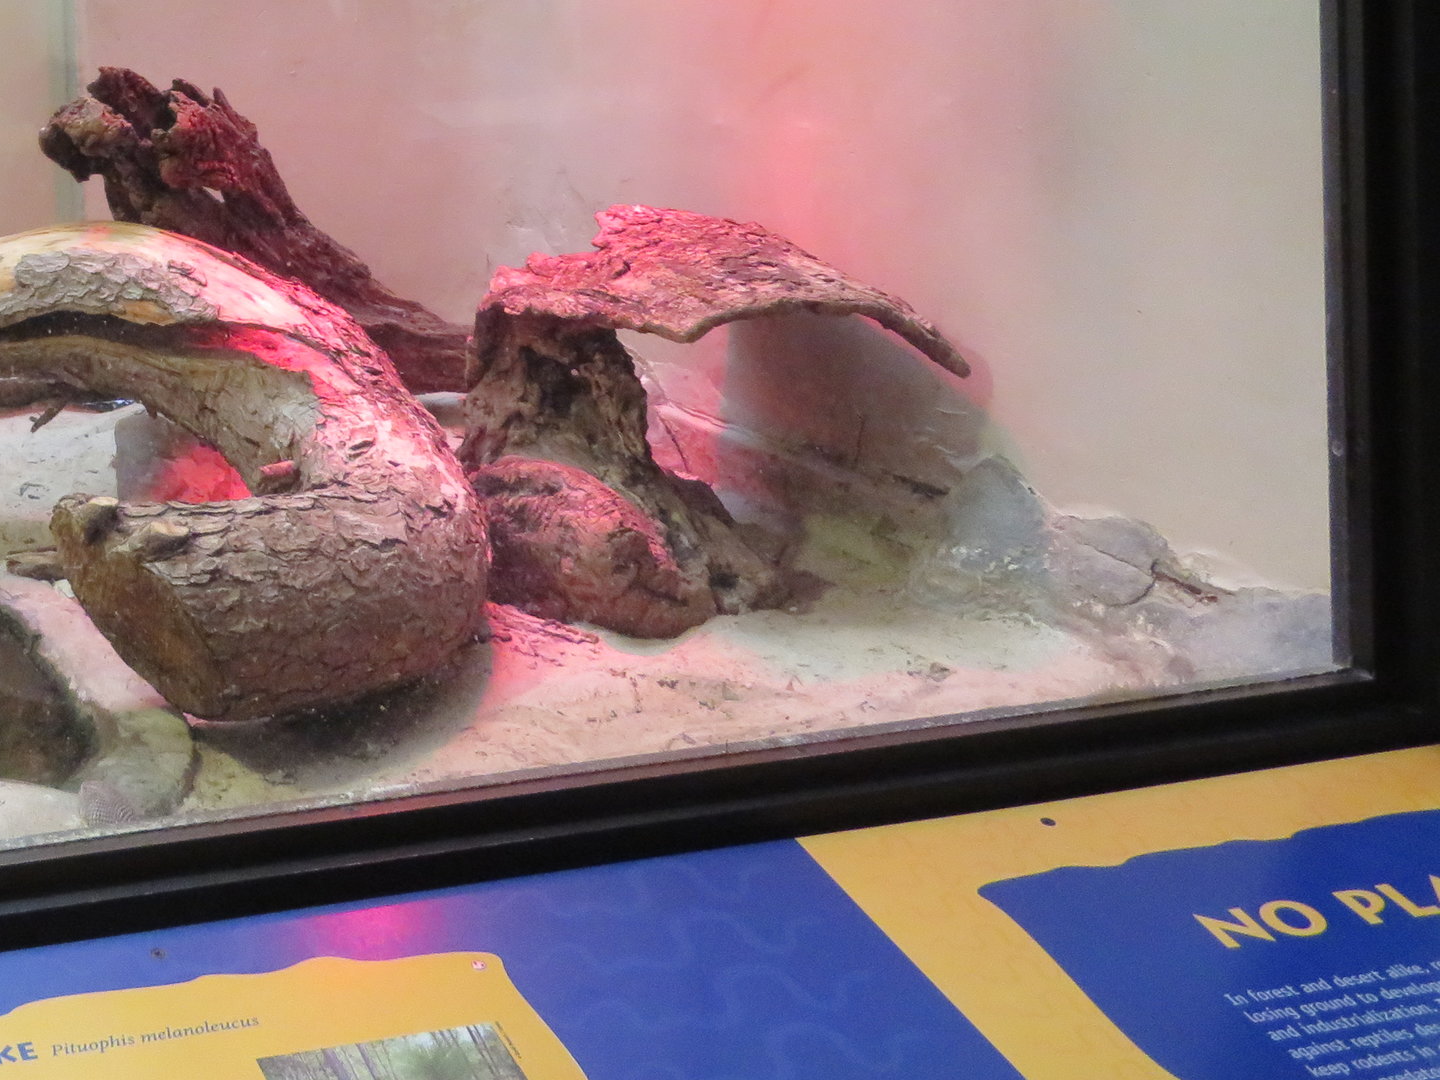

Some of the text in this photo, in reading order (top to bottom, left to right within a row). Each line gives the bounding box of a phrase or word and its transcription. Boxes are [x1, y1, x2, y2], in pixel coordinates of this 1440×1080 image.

[1192, 899, 1328, 949] NO
[1223, 992, 1249, 1006] In
[1246, 985, 1300, 1002] forest
[1300, 977, 1332, 993] and
[1333, 971, 1386, 987] desert
[1385, 963, 1430, 978] alike,
[1243, 1007, 1301, 1023] losing
[1300, 993, 1357, 1017] ground
[1356, 992, 1379, 1004] to
[1267, 1004, 1438, 1041] and industrialization.
[52, 1032, 135, 1057] Pituophis
[141, 1016, 259, 1044] melanoleucus
[1287, 1038, 1351, 1060] against
[1350, 1028, 1414, 1048] reptiles
[1305, 1045, 1437, 1078] keep rodents in
